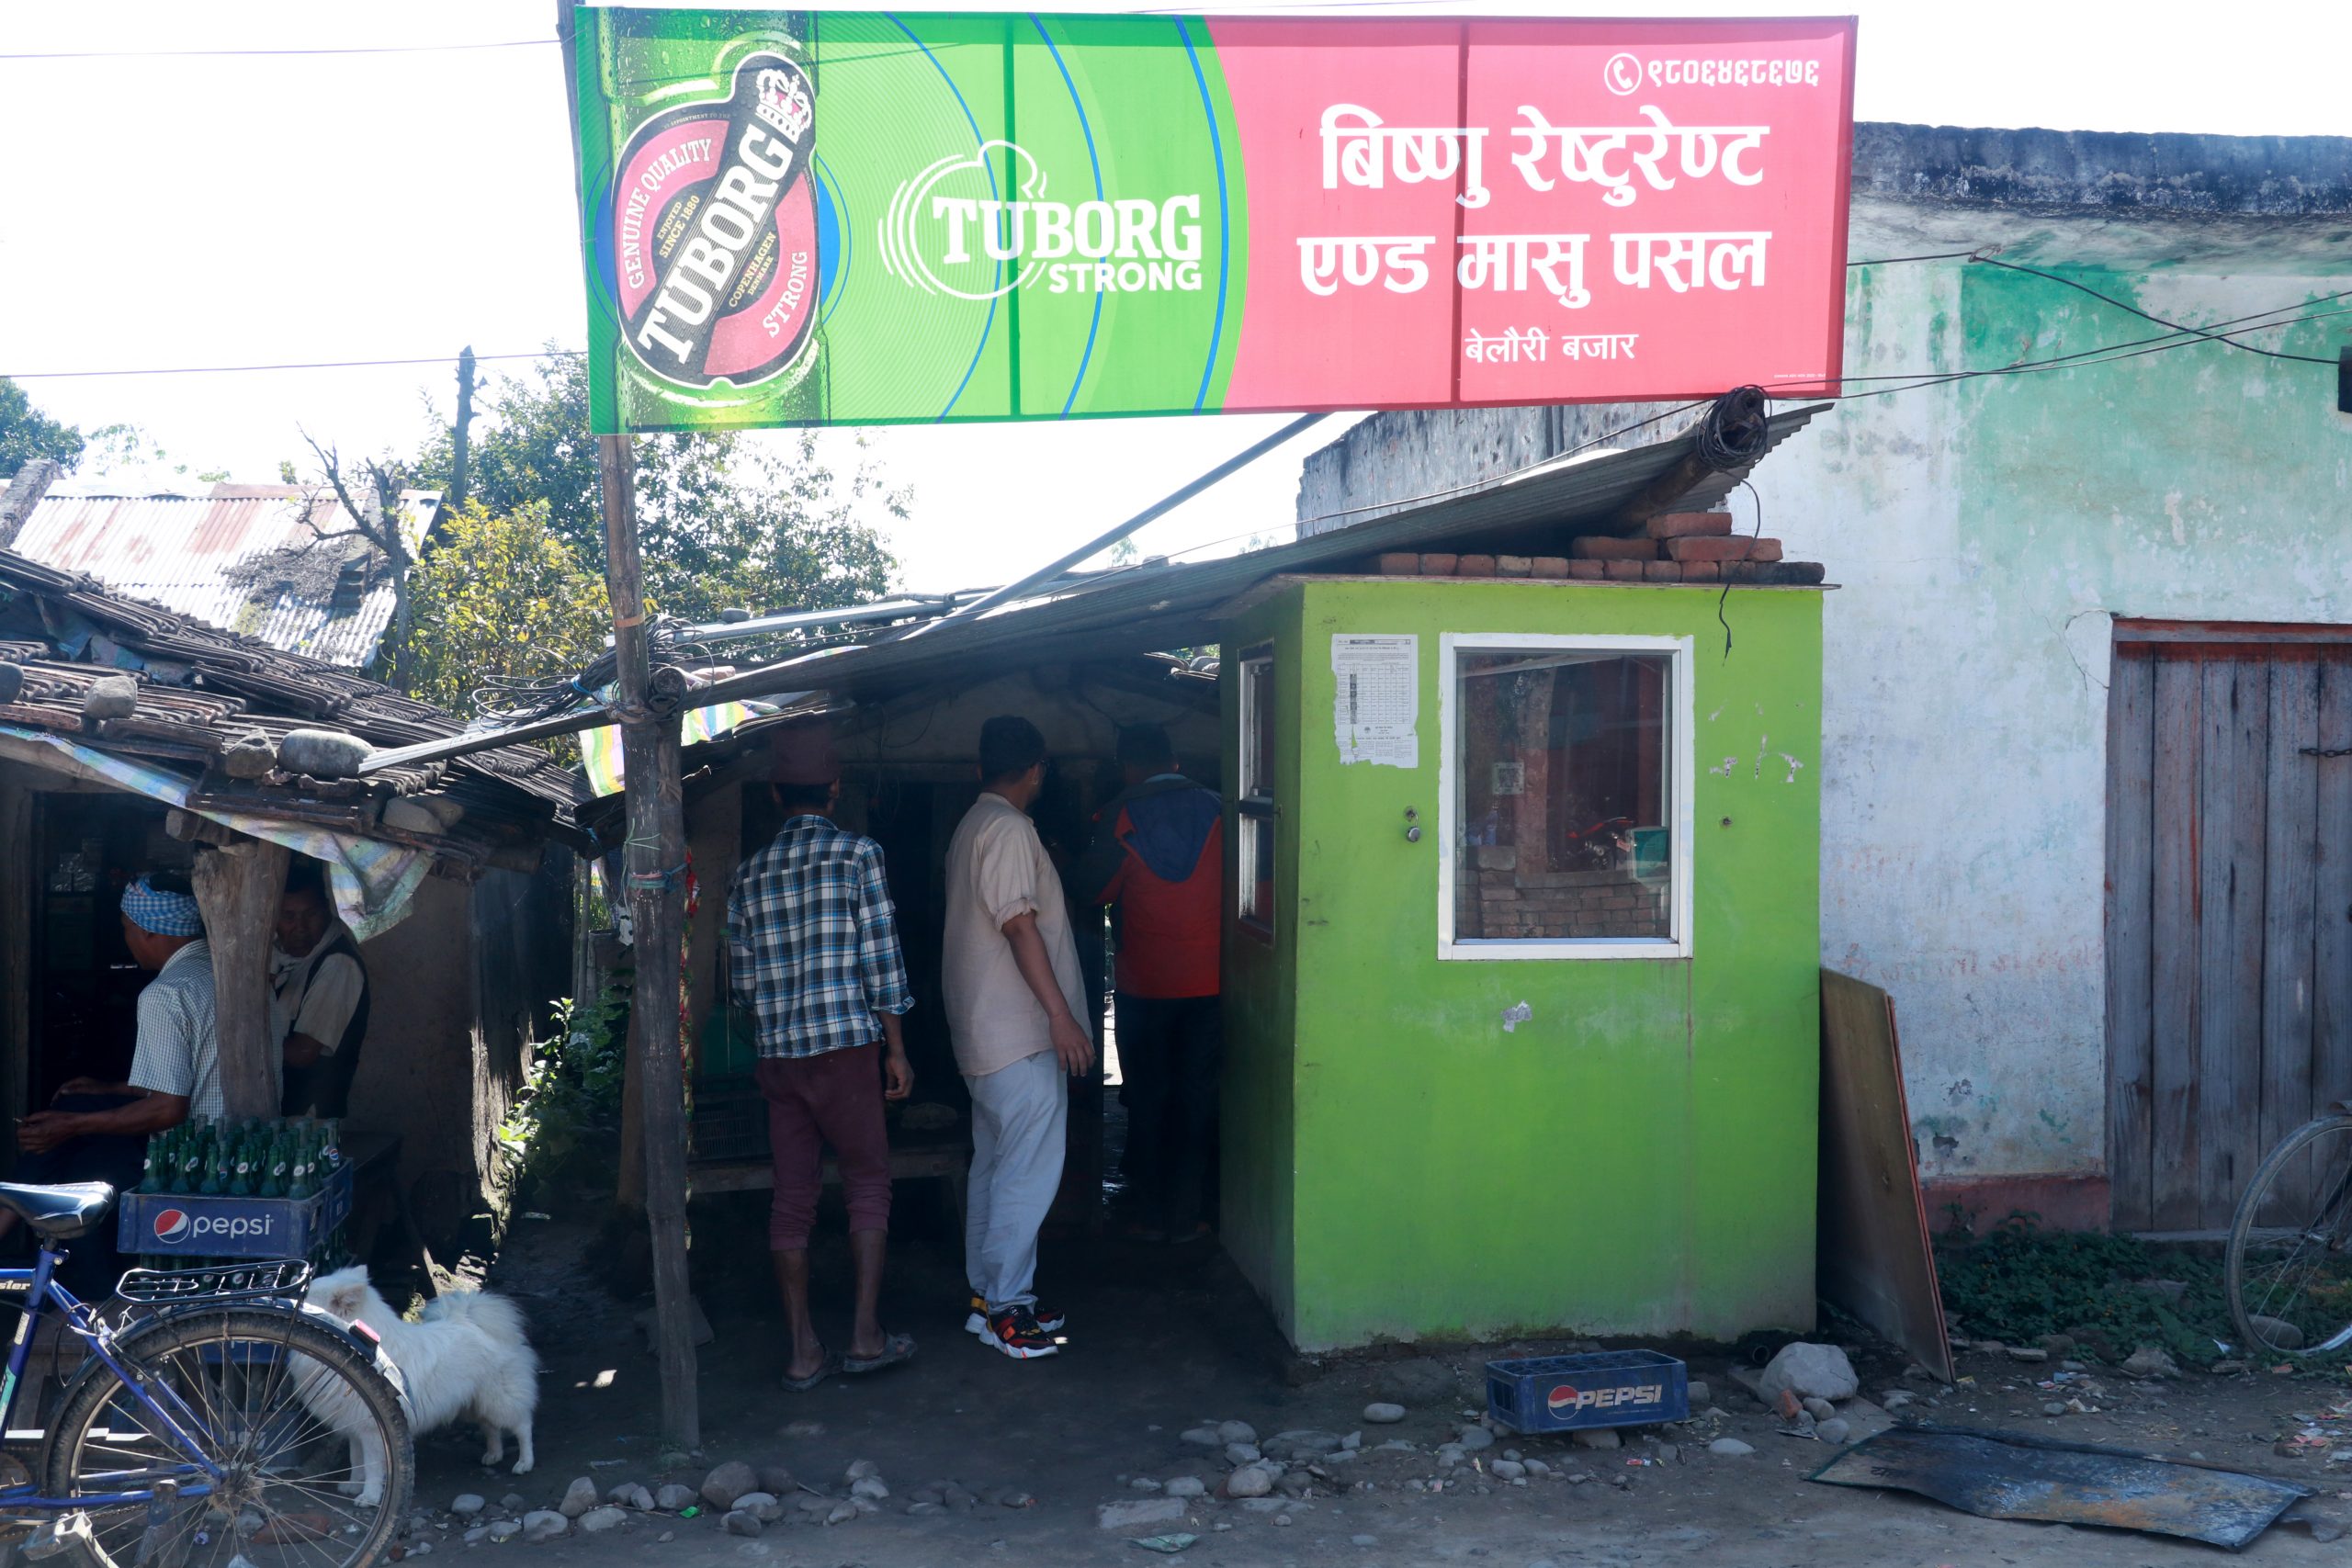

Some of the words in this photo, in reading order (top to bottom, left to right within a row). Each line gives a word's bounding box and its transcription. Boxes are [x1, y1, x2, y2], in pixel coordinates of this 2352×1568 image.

[1320, 104, 1490, 209] बिष्णु
[622, 187, 650, 289] GENUINE
[644, 138, 712, 191] QUALITY
[637, 123, 794, 365] TUBORG
[657, 201, 683, 241] ENJOYED
[659, 219, 685, 259] SINCE
[682, 194, 700, 221] 1880
[933, 193, 1202, 265] TUBORG
[729, 231, 776, 308] COPENHAGEN
[748, 255, 774, 296] DENMARK
[763, 251, 808, 338] STRONG
[1048, 261, 1202, 293] STRONG
[1296, 236, 1435, 296] एण्ड
[1457, 234, 1590, 309] मासु
[1610, 231, 1773, 292] पसल
[1464, 326, 1550, 363] बेलौरी
[1561, 333, 1640, 361] बजार
[192, 1213, 270, 1239] pepsi
[1575, 1384, 1663, 1410] PEPSI
